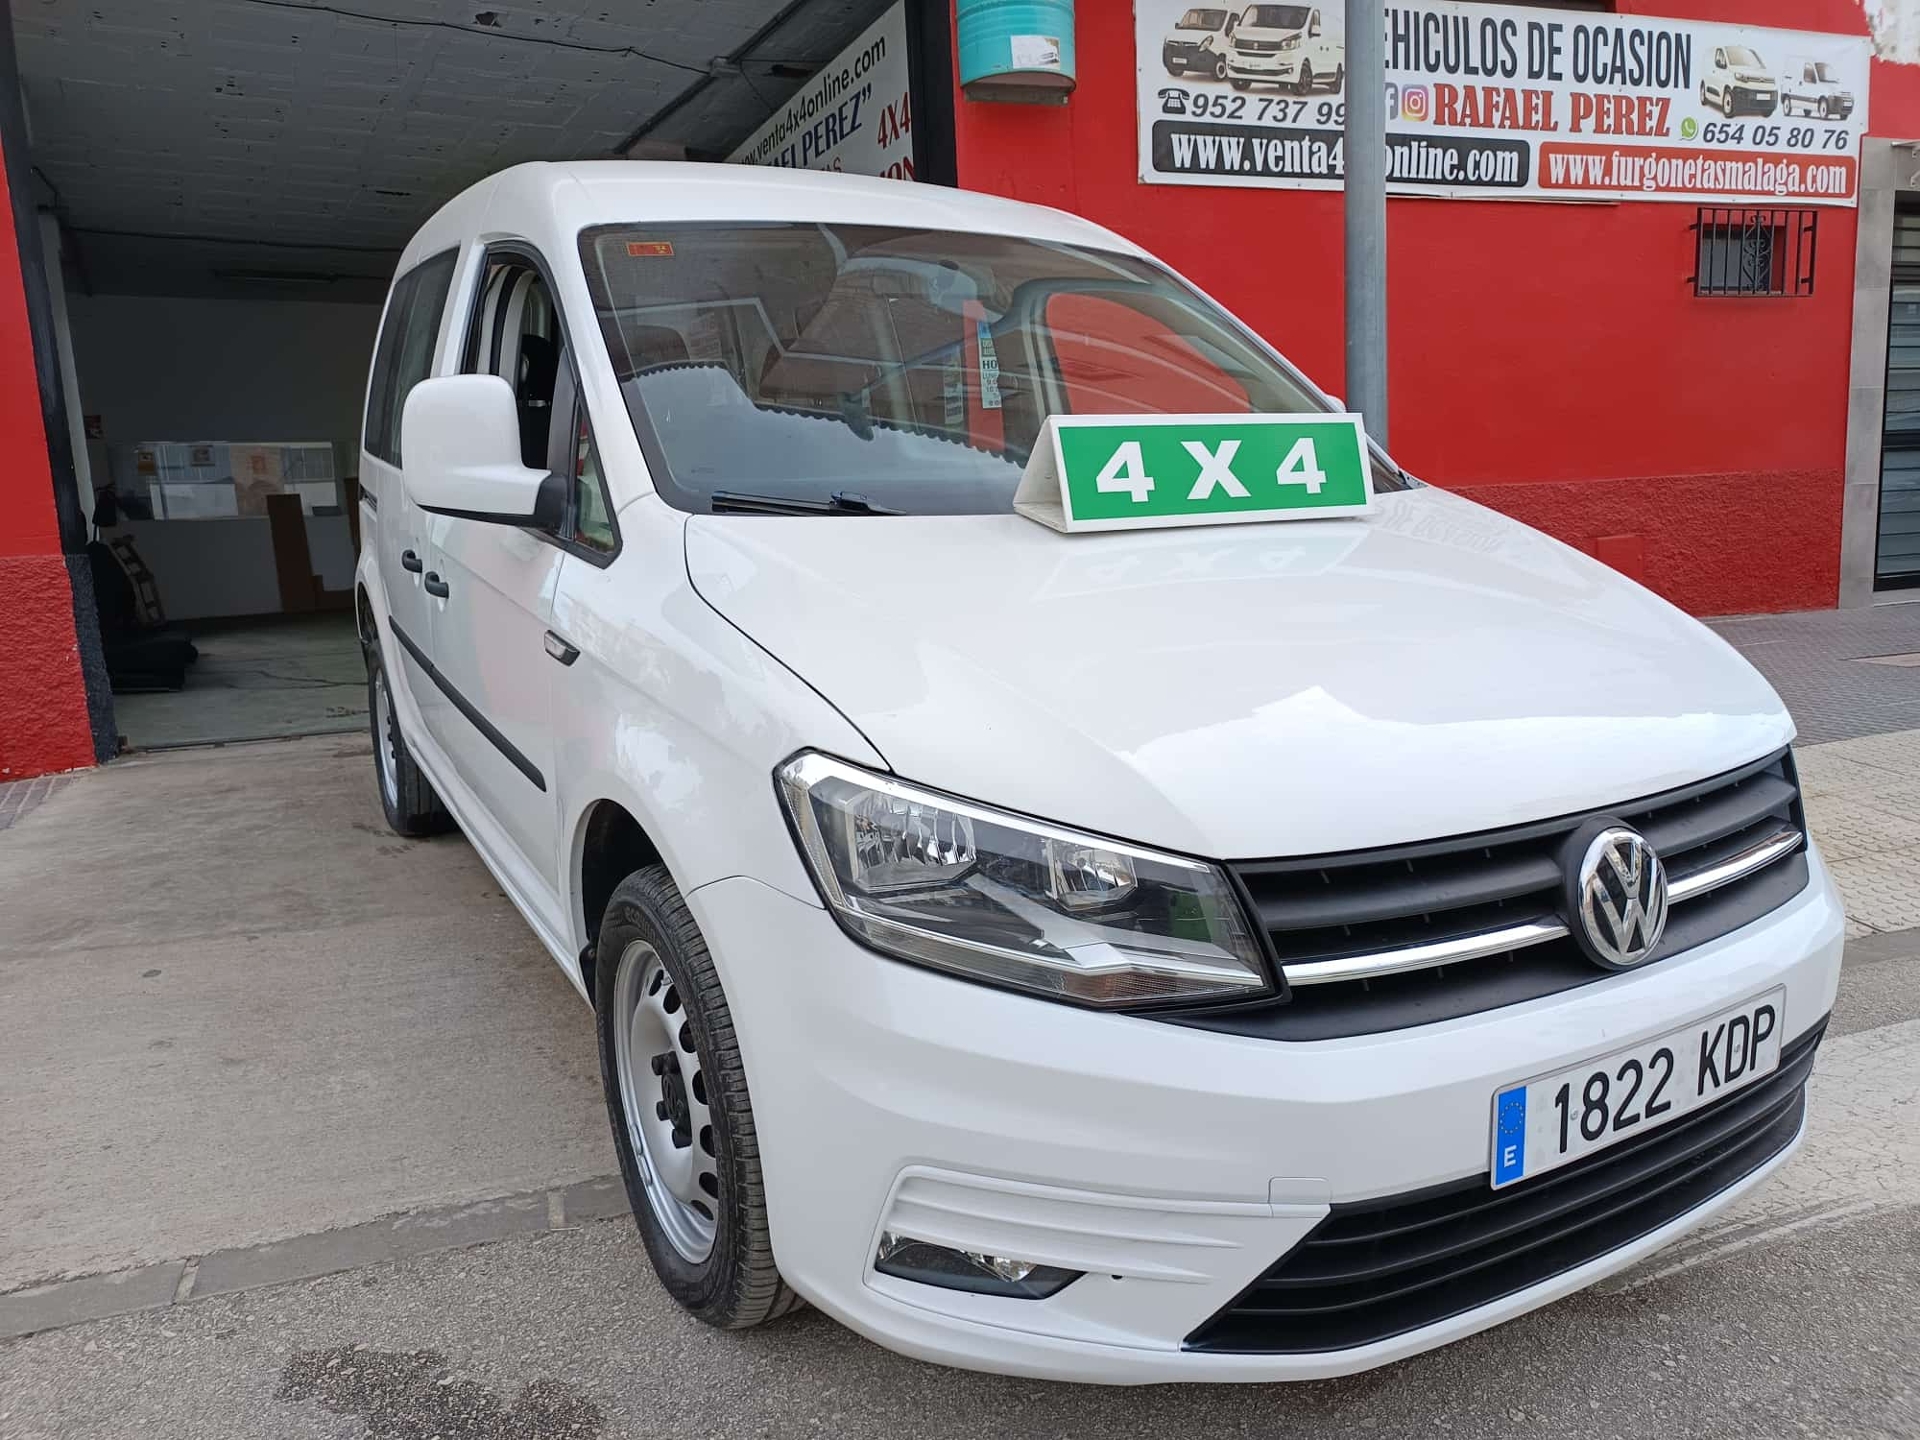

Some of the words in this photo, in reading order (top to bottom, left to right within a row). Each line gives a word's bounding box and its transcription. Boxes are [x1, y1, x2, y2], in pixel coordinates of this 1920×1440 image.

[1385, 8, 1517, 78] HICULOS
[1527, 21, 1563, 81] DE
[1573, 24, 1691, 89] OCASION
[1191, 93, 1246, 120] 952
[1256, 98, 1308, 124] 737
[1315, 101, 1345, 126] 99
[1433, 83, 1558, 132] RAFAEL
[1569, 91, 1671, 137] PEREZ
[1703, 122, 1745, 144] 654
[1752, 125, 1781, 147] 05
[1786, 127, 1815, 148] 80
[1821, 129, 1849, 150] 76
[1549, 151, 1847, 195] www.furgonetasmalaga.com
[1096, 441, 1155, 502] 4
[1181, 440, 1252, 500] X
[1276, 437, 1327, 494] 4
[1555, 1047, 1674, 1154] 1822
[1697, 1004, 1776, 1096] KDP
[1503, 1145, 1517, 1168] E
